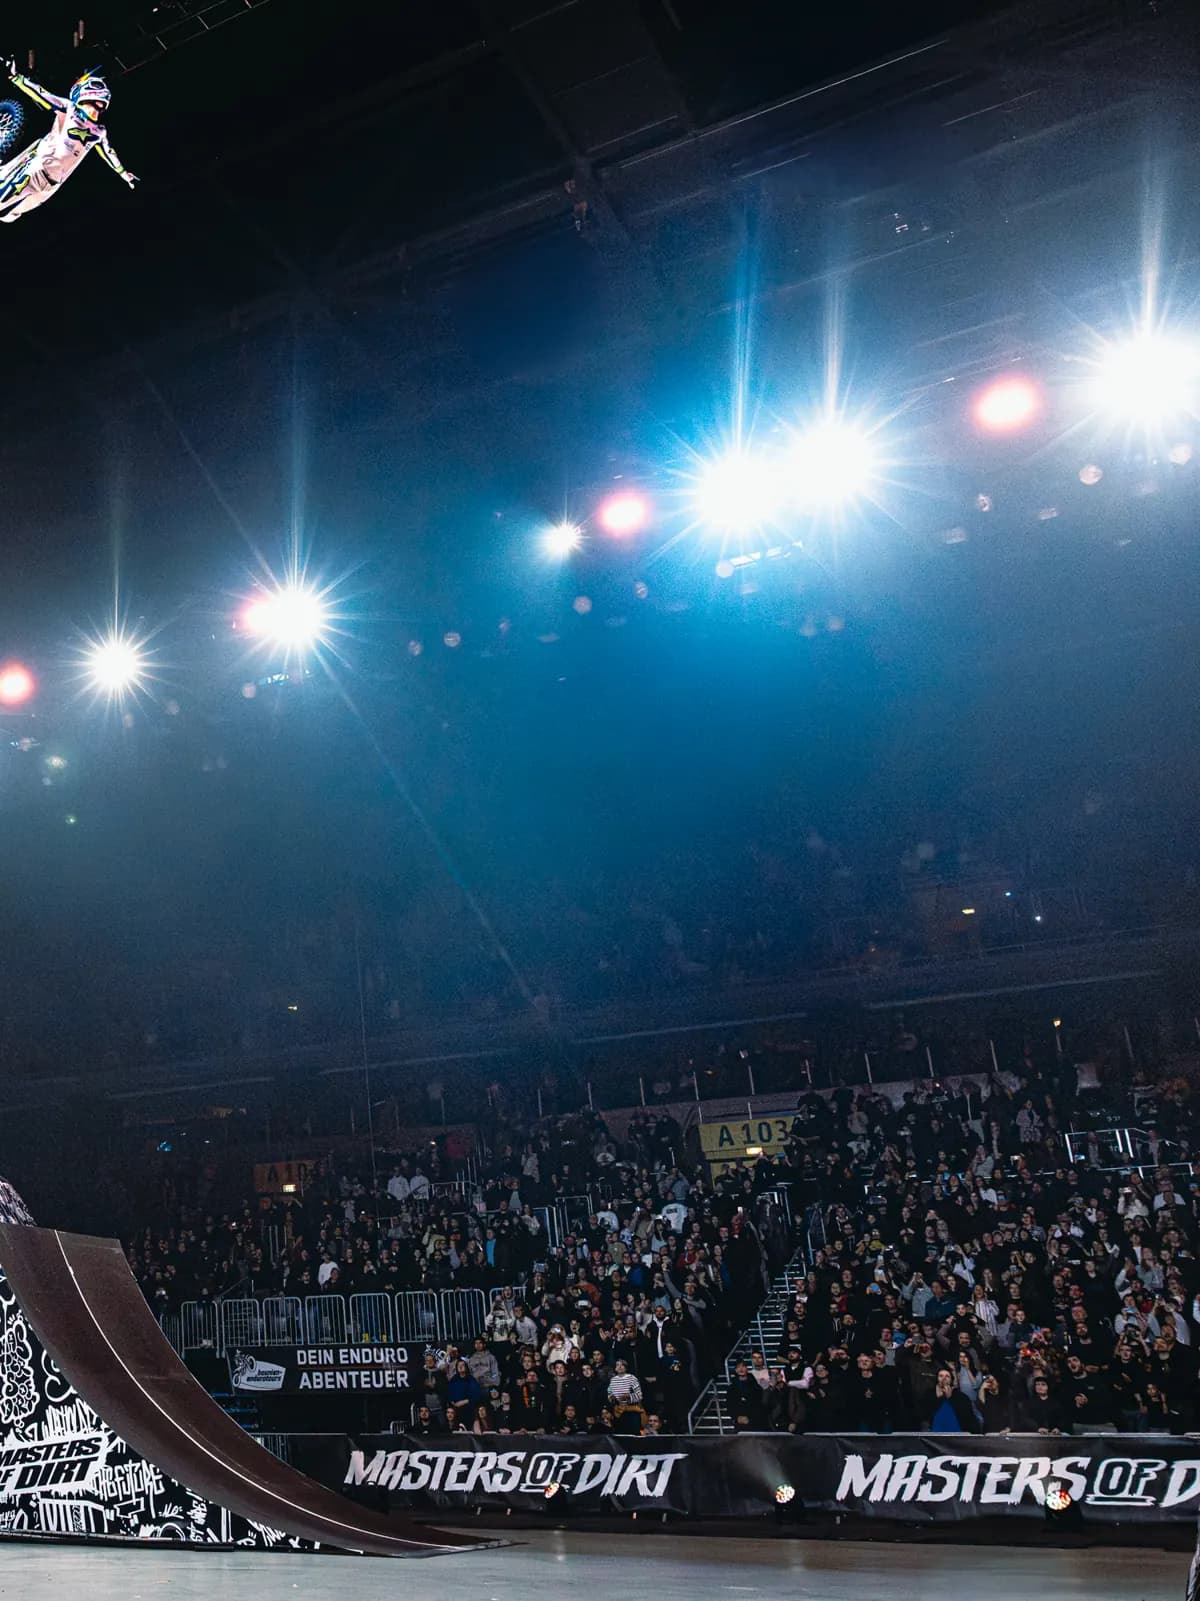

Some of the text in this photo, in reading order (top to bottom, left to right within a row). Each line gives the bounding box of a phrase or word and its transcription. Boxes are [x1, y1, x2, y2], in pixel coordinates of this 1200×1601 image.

[720, 1120, 789, 1147] A 103
[297, 1347, 409, 1366] DEIN ENDURO
[299, 1369, 410, 1390] ABENTEUER
[14, 1456, 99, 1490] DIRT
[344, 1450, 689, 1498] MASTERS OF DIRT
[835, 1453, 1092, 1506] MASTERS
[1085, 1457, 1168, 1507] OF
